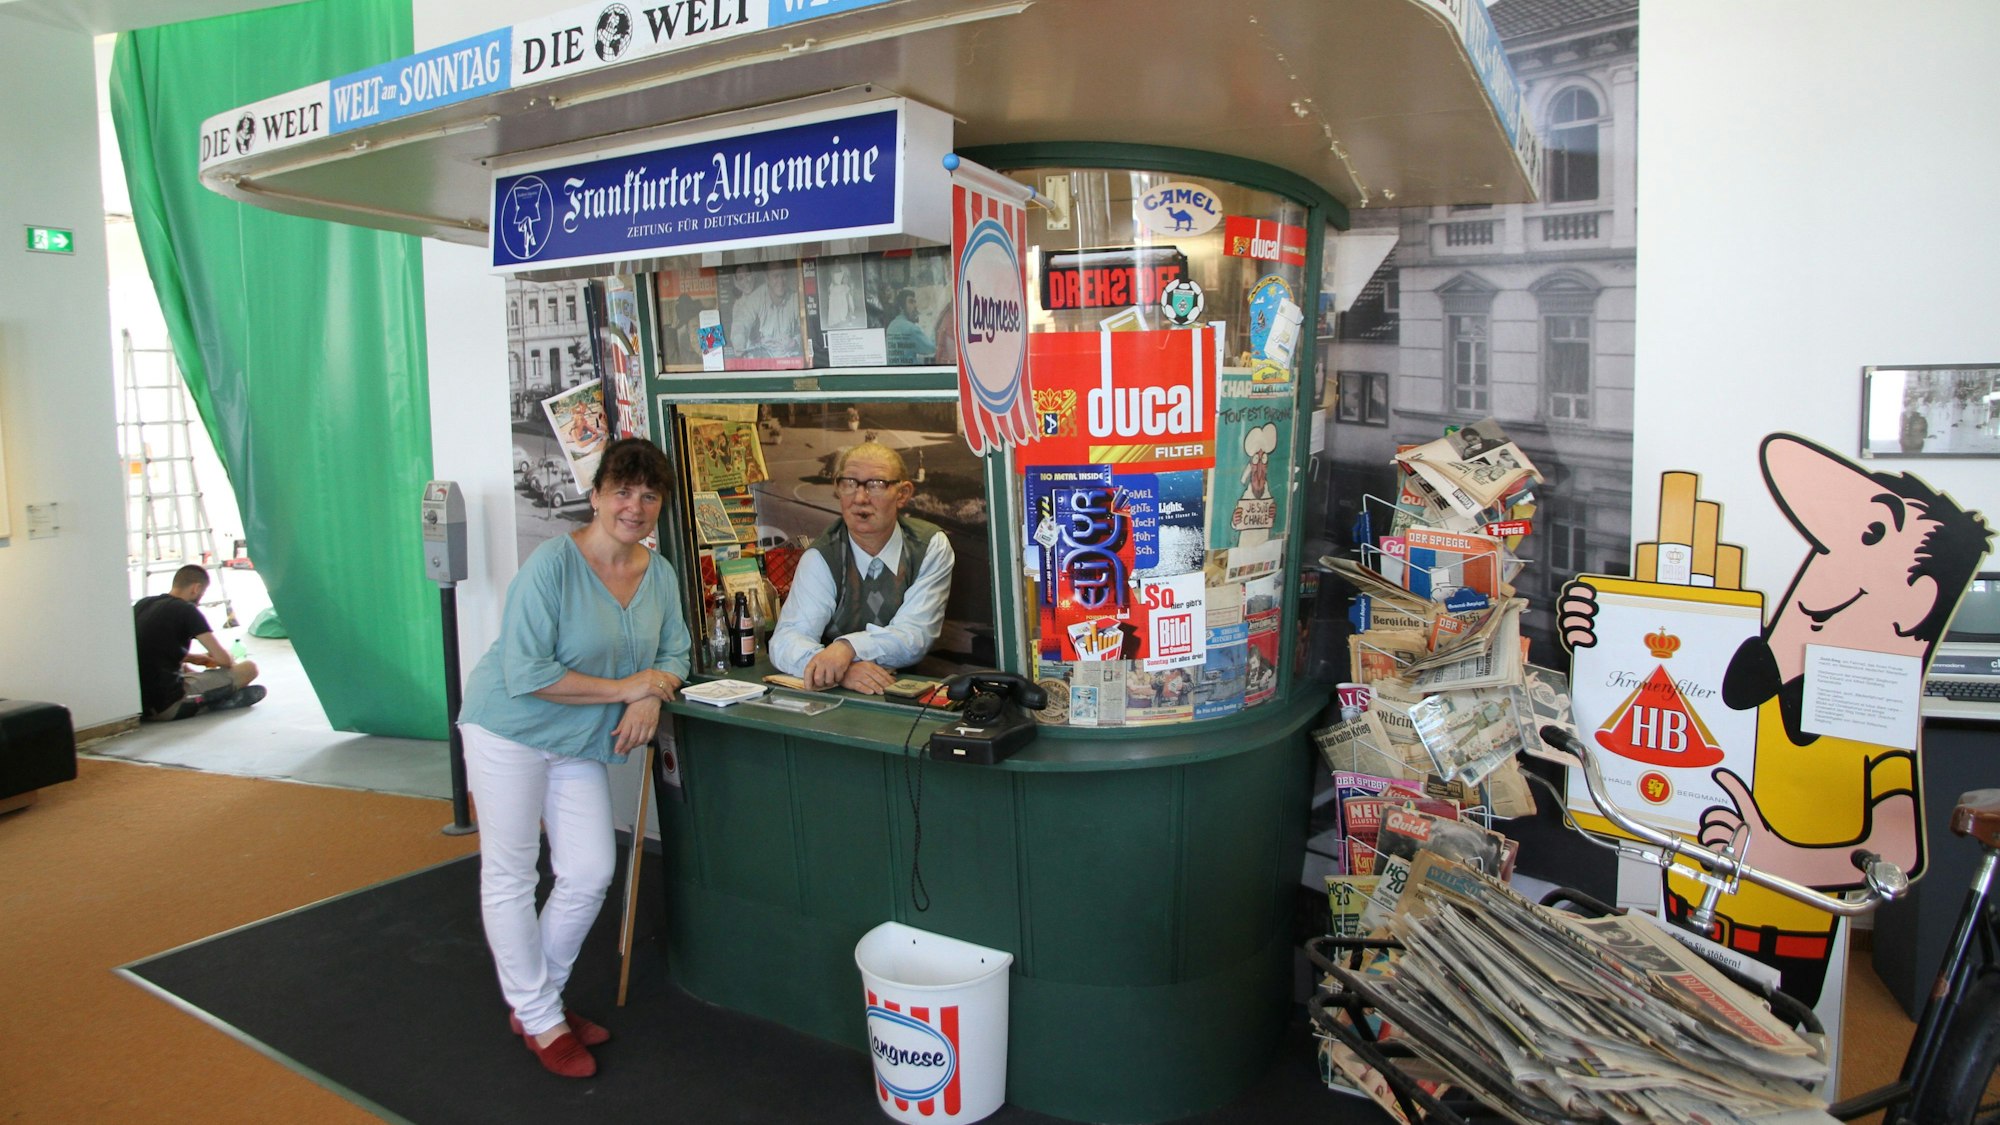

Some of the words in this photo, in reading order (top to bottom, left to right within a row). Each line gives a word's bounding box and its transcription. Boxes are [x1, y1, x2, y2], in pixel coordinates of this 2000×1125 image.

[523, 27, 585, 75] DIE
[643, 0, 752, 44] WELT
[334, 76, 383, 124] WELT
[381, 85, 398, 101] am
[400, 40, 500, 106] SONNTAG
[202, 127, 231, 162] DIE
[262, 102, 323, 143] WELT
[563, 166, 705, 233] Frankfurter
[706, 135, 879, 214] Allgemeine
[1142, 188, 1216, 216] CAMEL
[627, 222, 673, 239] ZEITUNG
[677, 217, 699, 232] FÜR
[703, 207, 790, 228] DEUTSCHLAND
[1250, 218, 1281, 261] ducal
[966, 280, 1021, 344] Langnese
[1087, 326, 1204, 438] ducal
[1154, 444, 1204, 459] FILTER
[1040, 472, 1053, 481] NO
[1053, 472, 1078, 481] METAL
[1078, 472, 1104, 481] INSIDE
[1158, 501, 1185, 515] Lights.
[1408, 532, 1428, 545] DER
[1429, 534, 1471, 549] SPIEGEL
[1500, 526, 1525, 536] TAGE
[1144, 584, 1174, 611] So
[1171, 601, 1185, 610] hier
[1159, 616, 1191, 648] Bild
[1439, 617, 1458, 631] DER
[1146, 659, 1169, 667] Sonntag
[1604, 670, 1717, 701] Kronenfilter
[1351, 722, 1372, 739] Krieg
[1629, 704, 1689, 754] HB
[1336, 776, 1355, 786] DER
[1608, 777, 1632, 787] HAUS
[1676, 789, 1729, 806] BERGMANN
[1387, 814, 1428, 838] Quick
[1328, 881, 1354, 896] HÖR
[1386, 879, 1405, 895] ZU
[1694, 943, 1706, 954] Sie
[1706, 949, 1742, 970] stöbern!
[869, 1025, 946, 1067] Langnese
